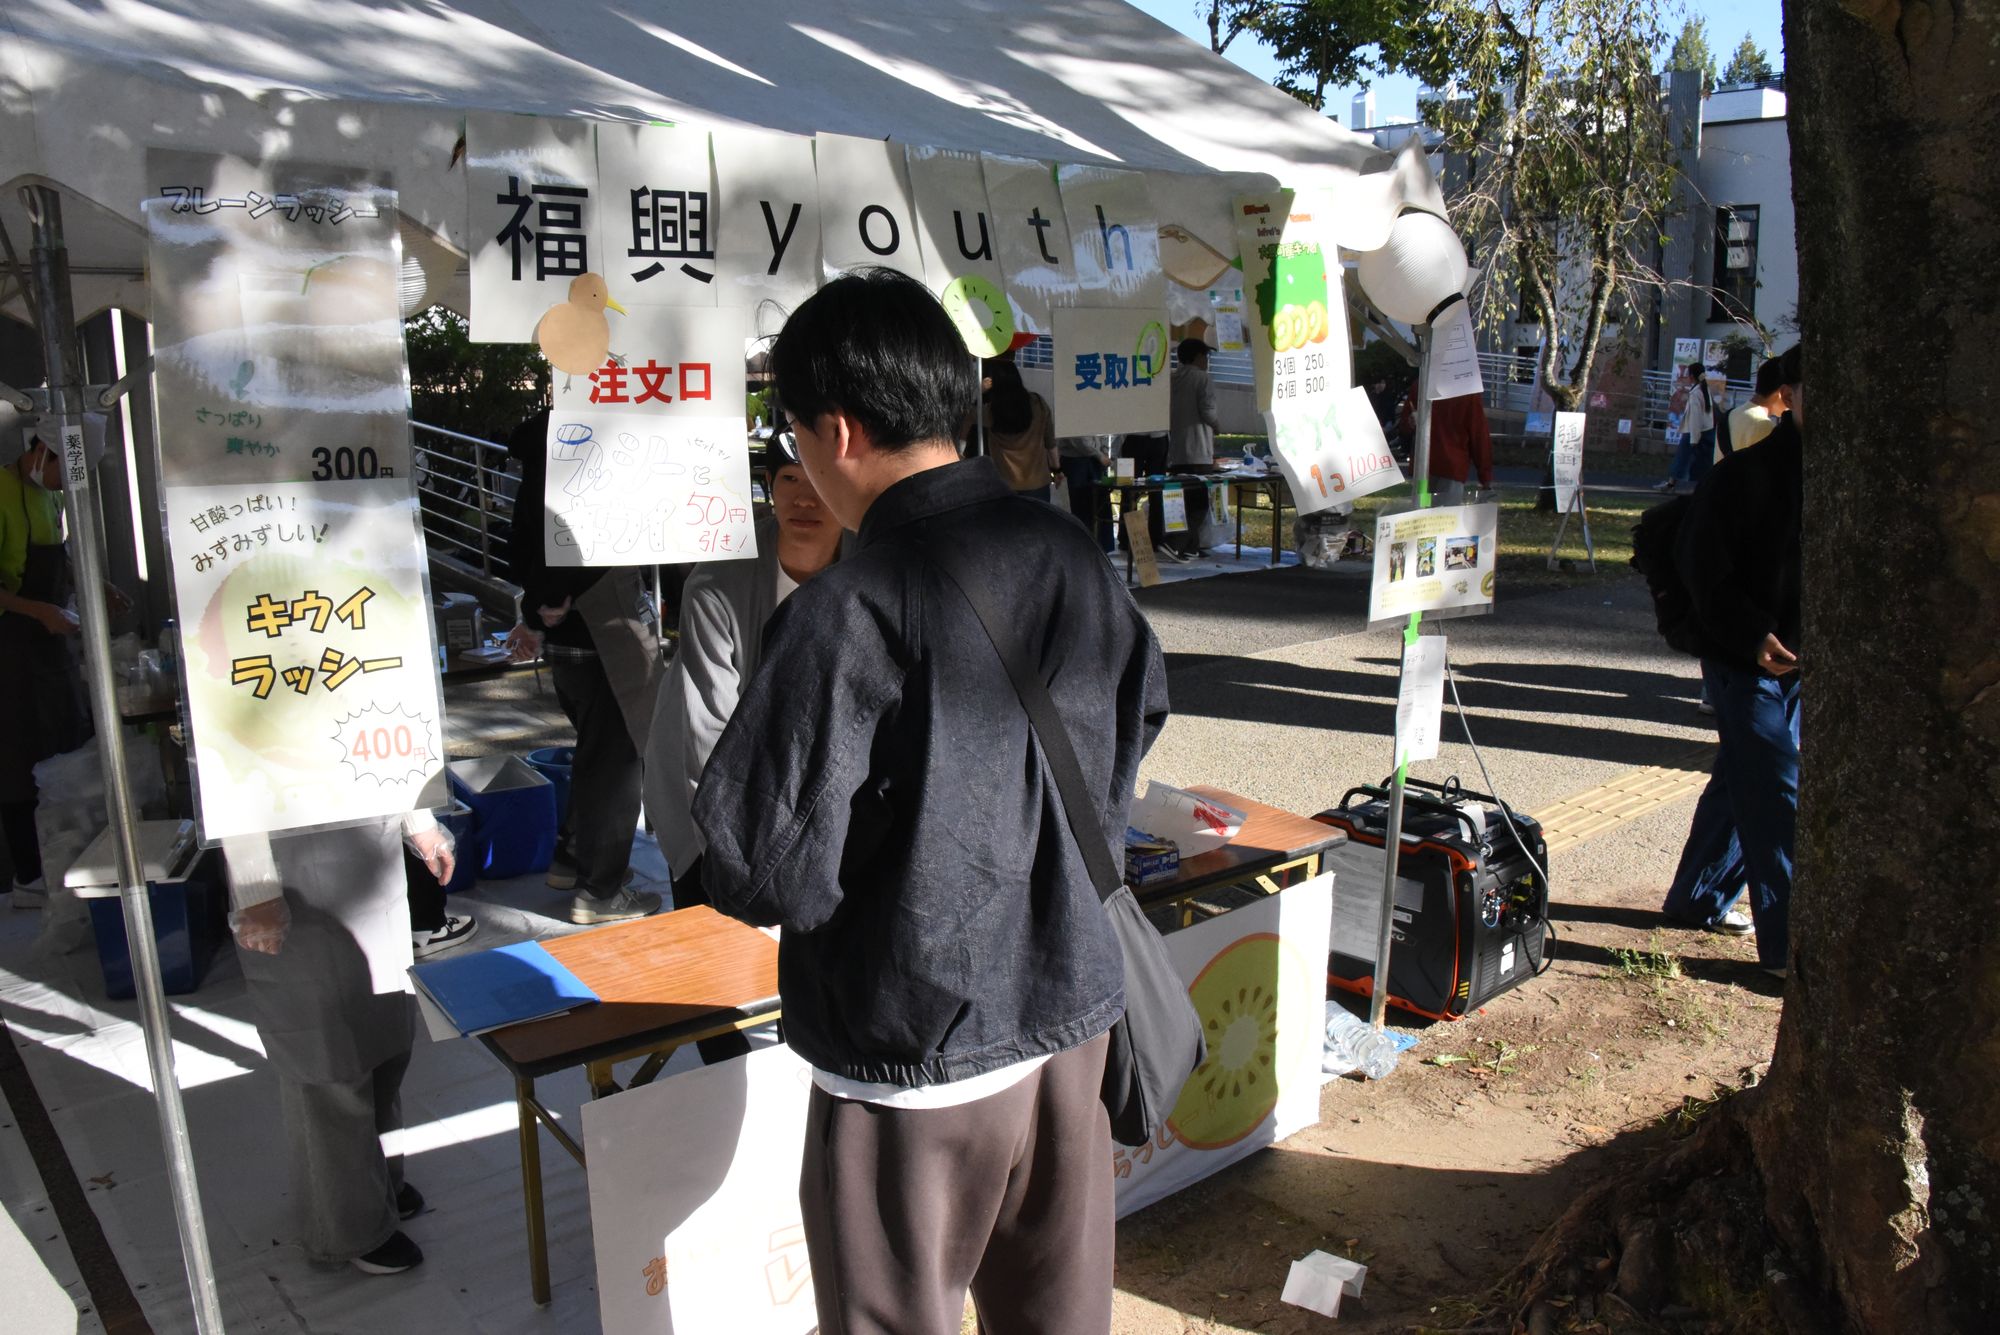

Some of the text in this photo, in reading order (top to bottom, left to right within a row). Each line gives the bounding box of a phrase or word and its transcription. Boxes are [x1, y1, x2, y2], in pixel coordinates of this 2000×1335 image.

[160, 186, 380, 225] プレーンラッシー
[495, 175, 715, 284] 福興
[588, 359, 712, 405] 注文口
[1074, 353, 1153, 391] 受取口
[1275, 352, 1329, 376] 3個 250
[1277, 375, 1329, 400] 6個 500
[195, 407, 261, 429] さっぱり
[65, 432, 86, 482] 薬学部
[225, 437, 281, 458] 爽やか
[311, 446, 394, 482] 300円
[686, 491, 747, 526] 50円
[247, 586, 376, 639] キウイ
[231, 647, 403, 700] ラッシー
[352, 724, 427, 763] 400円
